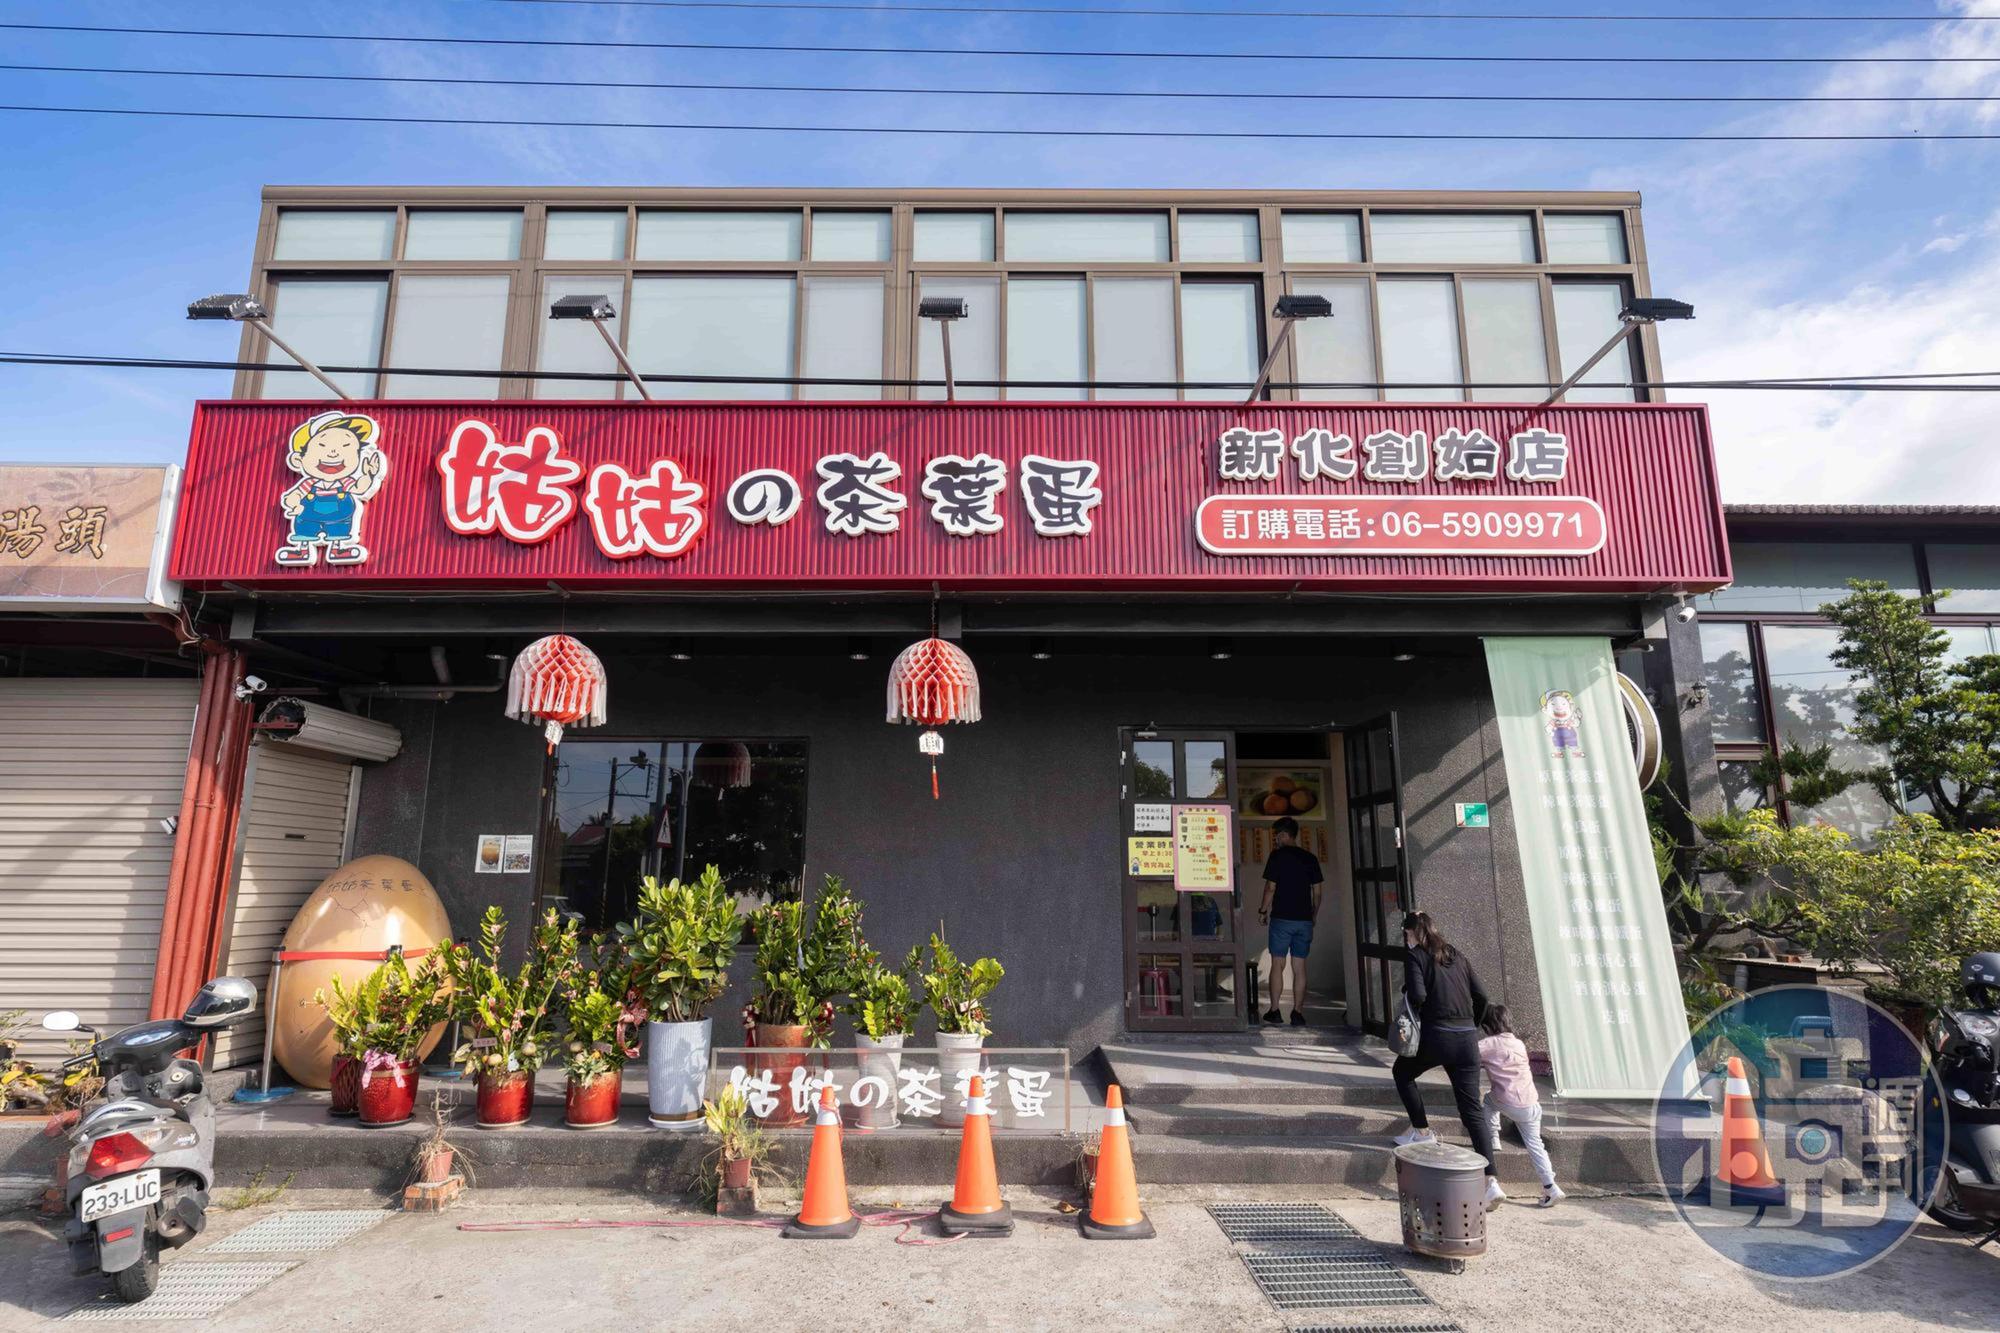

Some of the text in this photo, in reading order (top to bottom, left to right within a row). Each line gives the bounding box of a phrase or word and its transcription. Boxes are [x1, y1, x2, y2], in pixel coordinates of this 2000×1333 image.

[1219, 427, 1568, 483] 新化創始店
[438, 417, 1102, 559] 姑姑の茶葉蛋
[1221, 508, 1584, 540] 訂購電話:06-5909971
[85, 1181, 158, 1216] 233-LUC
